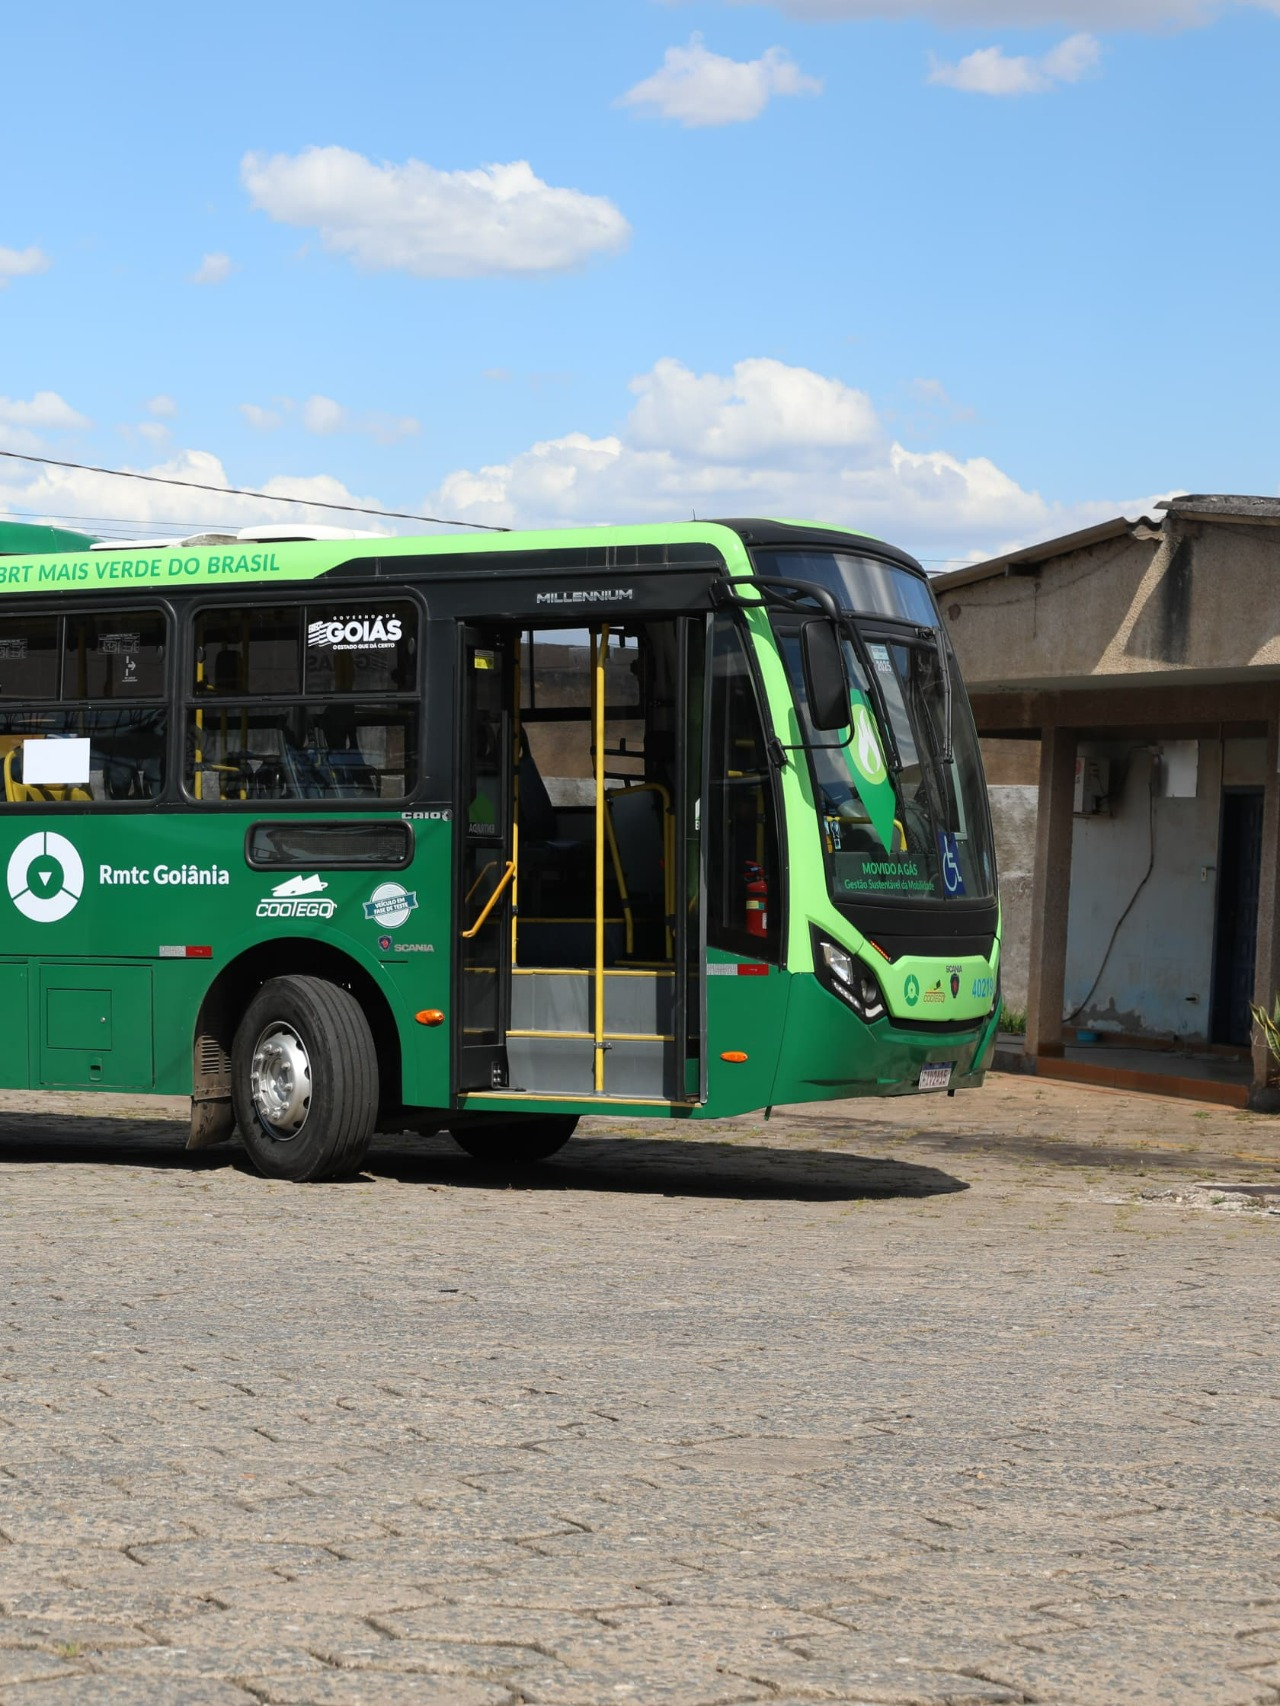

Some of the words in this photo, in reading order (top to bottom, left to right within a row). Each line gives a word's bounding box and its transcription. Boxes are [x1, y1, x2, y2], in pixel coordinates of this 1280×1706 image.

[37, 562, 89, 582] MAIS
[95, 559, 161, 579] VERDE
[167, 557, 200, 576] DO
[207, 553, 280, 574] BRASIL
[536, 588, 633, 604] MILLENNIUM
[326, 615, 402, 643] GOIÁS
[401, 811, 441, 820] CAIO
[99, 864, 150, 885] Rmtc
[153, 864, 230, 885] Goiânia
[862, 862, 896, 875] MOVIDO
[898, 863, 903, 875] A
[903, 860, 918, 876] GÁS
[255, 900, 335, 919] COOTEGO
[394, 943, 434, 952] SCANIA
[945, 965, 962, 973] SCANIA
[972, 977, 994, 998] 40219
